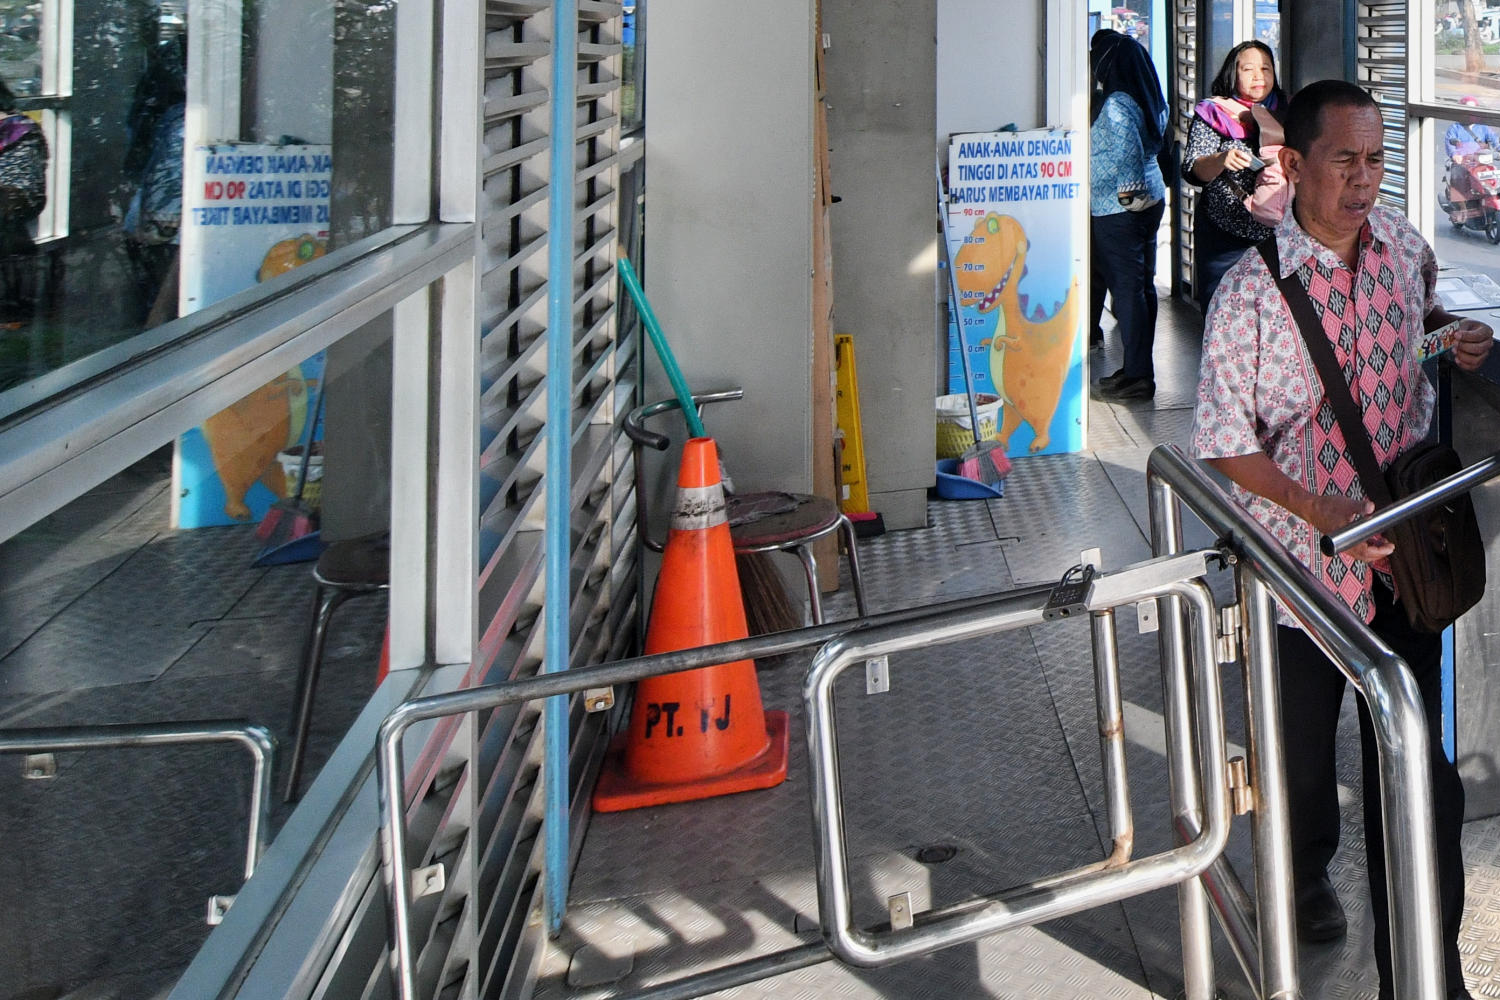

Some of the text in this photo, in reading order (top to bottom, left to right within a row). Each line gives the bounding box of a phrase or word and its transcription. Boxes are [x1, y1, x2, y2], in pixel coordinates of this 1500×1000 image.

[958, 139, 1072, 159] ANAK-ANAK DENGAN
[958, 160, 1072, 181] TINGGI DI ATAS 90 CM
[950, 182, 1081, 204] HARUS MEMBAYAR TIKET
[963, 208, 973, 216] 90
[963, 236, 973, 244] 80
[963, 263, 973, 271] 70
[963, 318, 973, 326] 50
[645, 702, 683, 739] PT.
